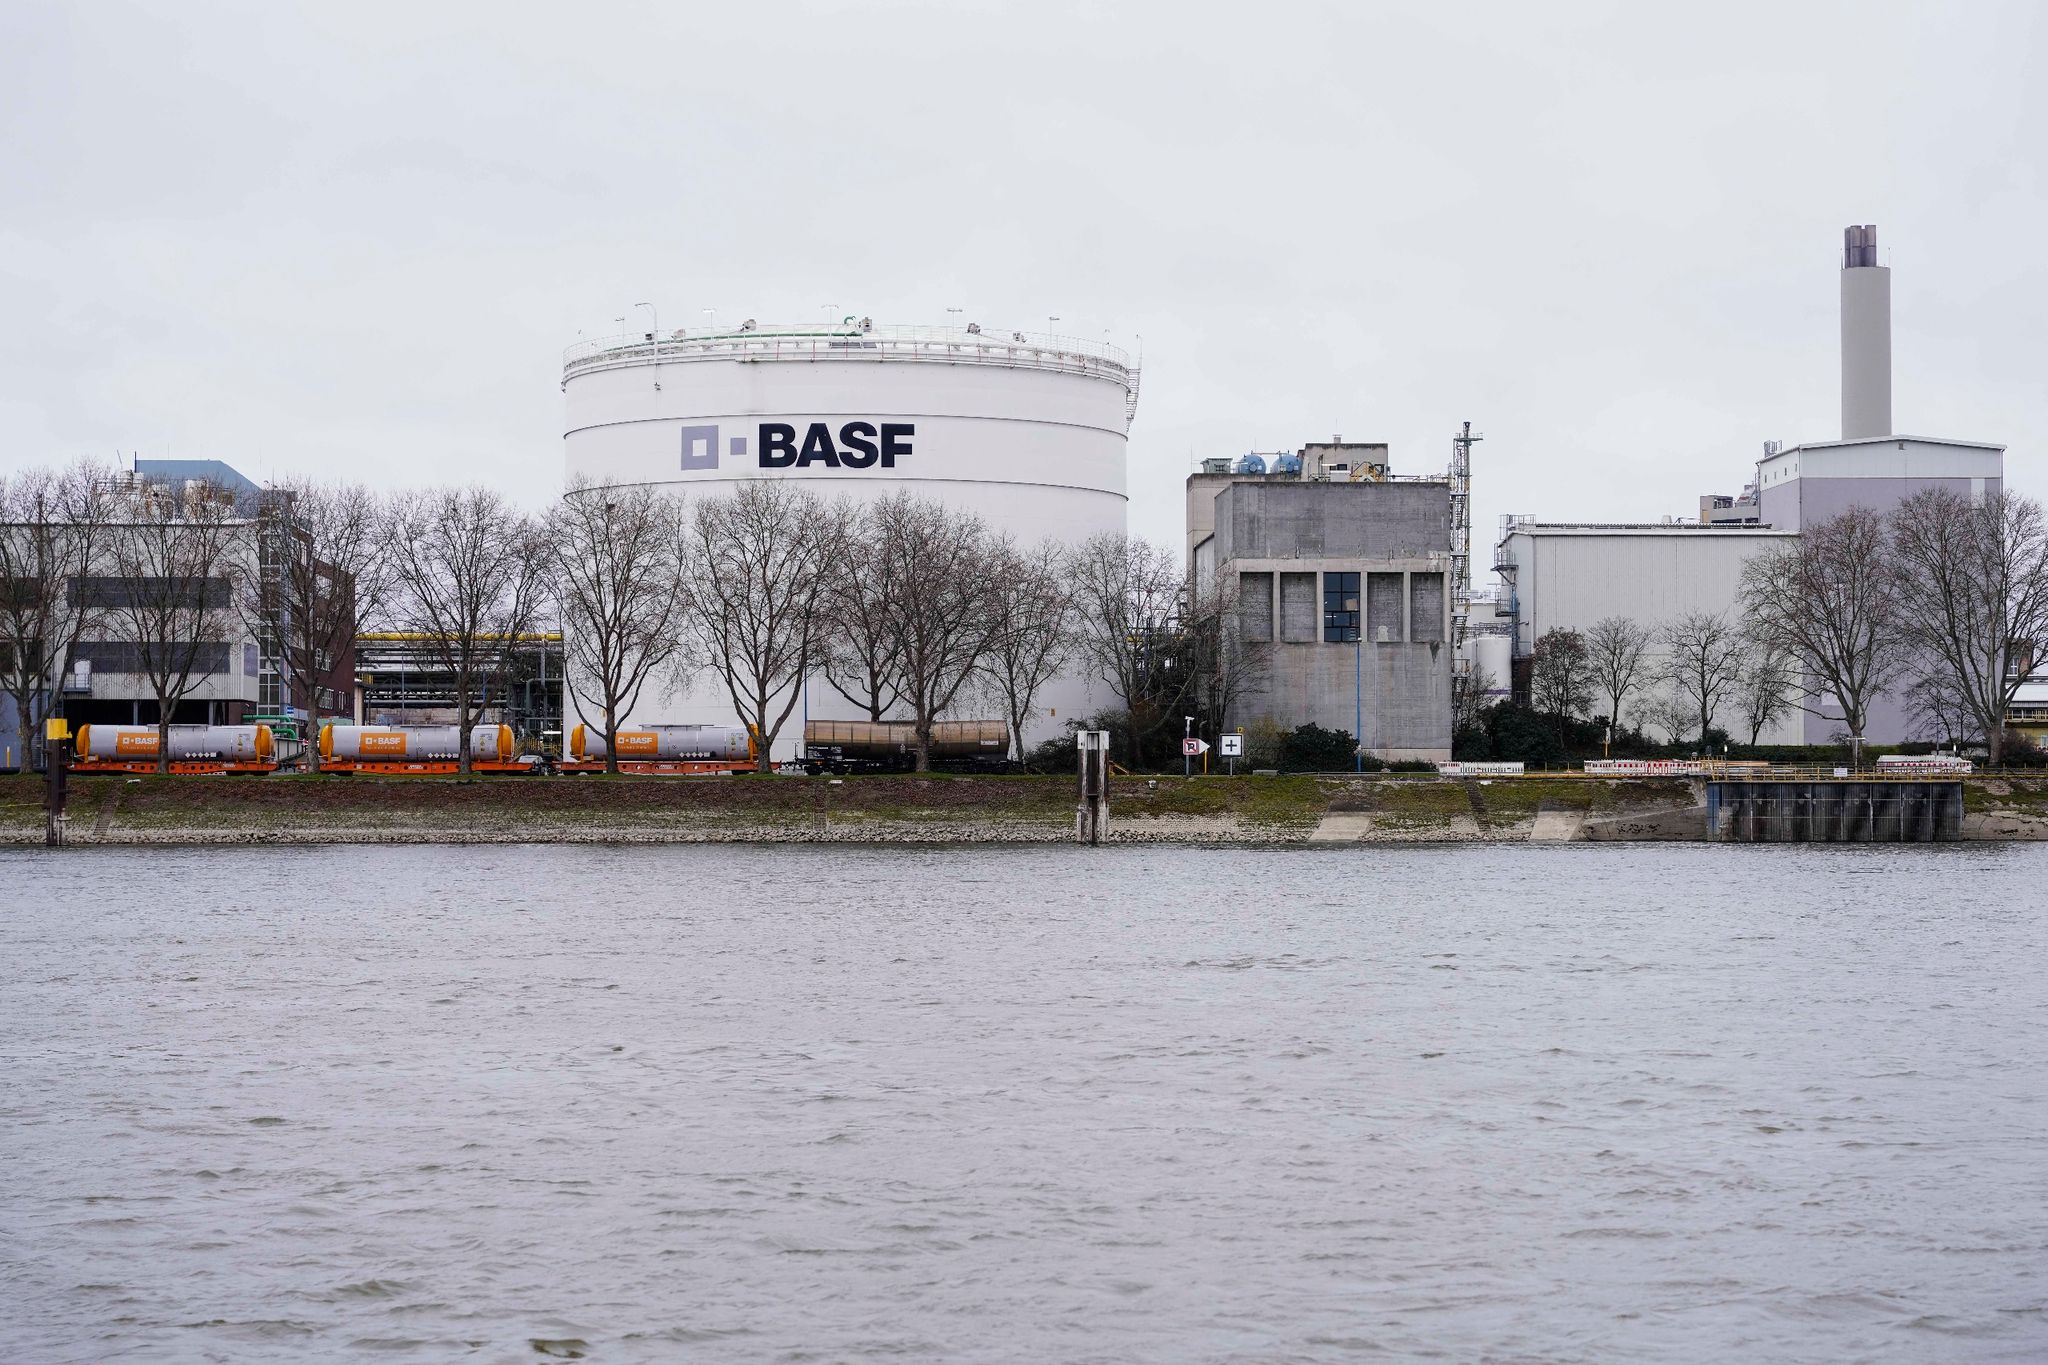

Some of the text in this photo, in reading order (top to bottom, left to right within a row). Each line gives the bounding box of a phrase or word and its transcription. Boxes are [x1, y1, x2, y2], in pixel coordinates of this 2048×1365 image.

[759, 421, 915, 468] BASF
[134, 737, 158, 745] BASF
[377, 737, 401, 745] BASF
